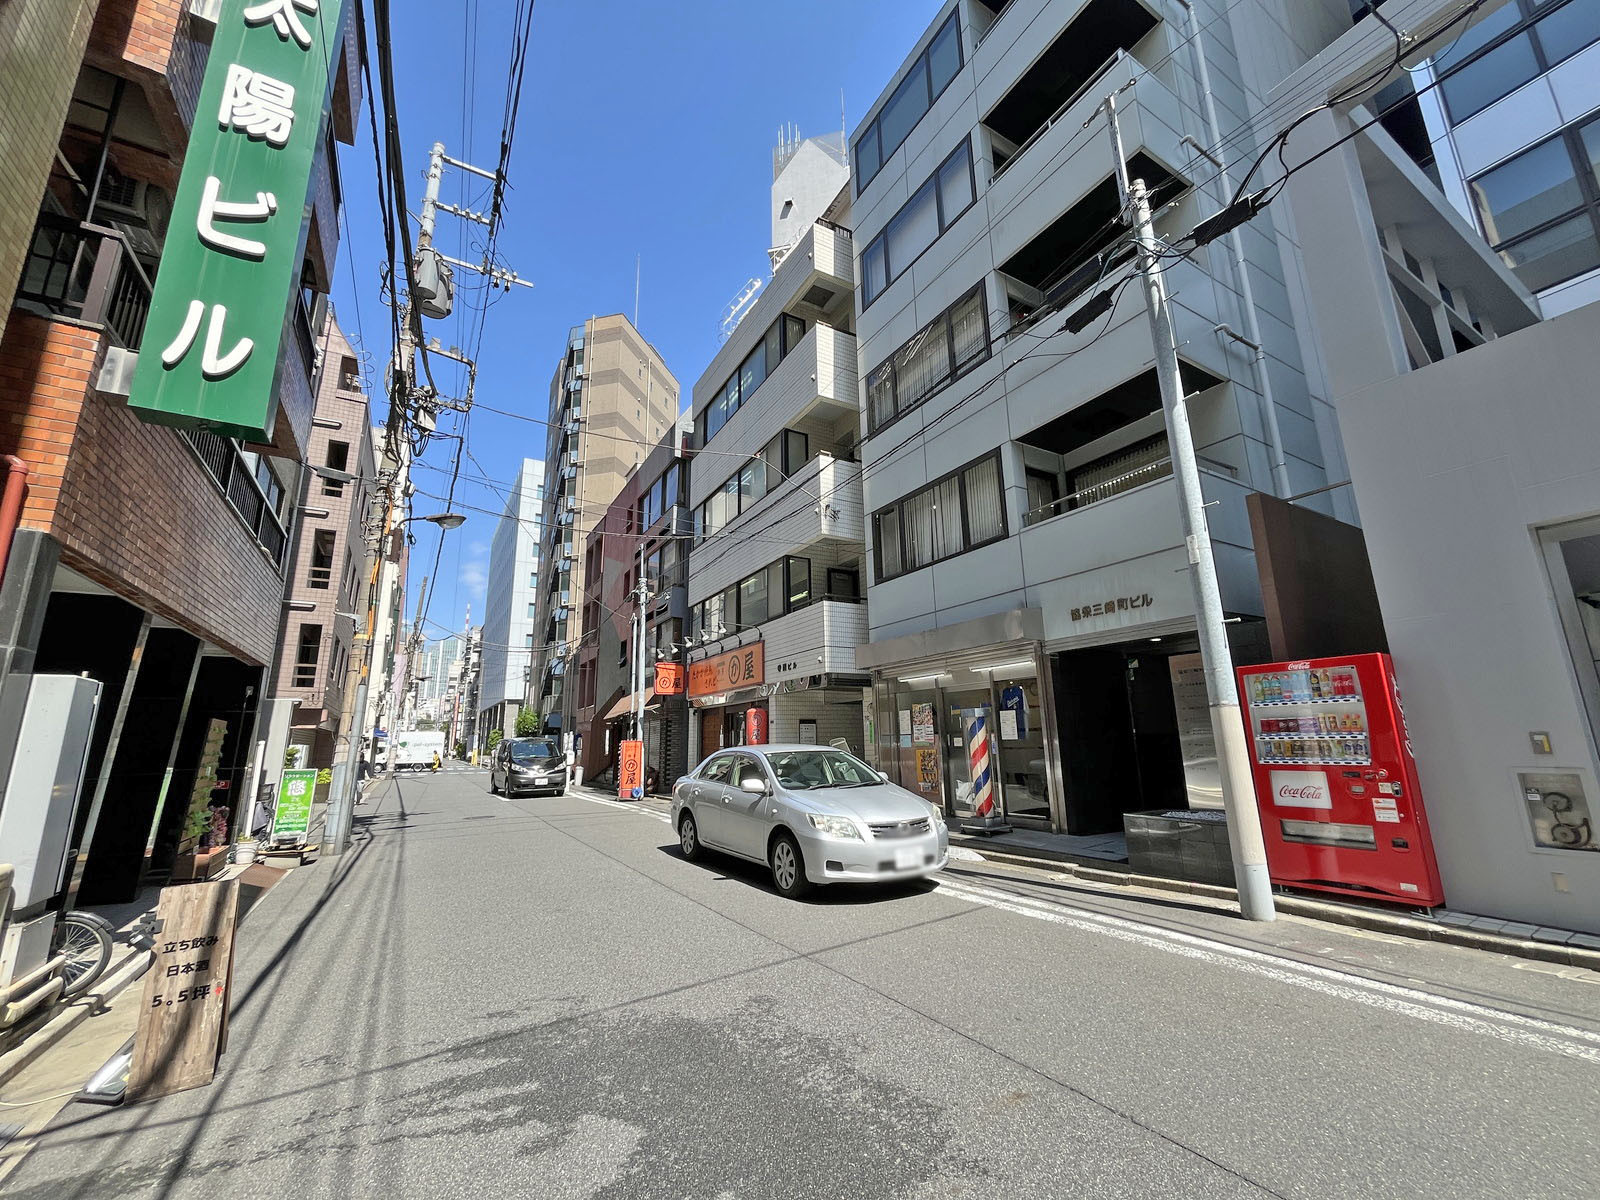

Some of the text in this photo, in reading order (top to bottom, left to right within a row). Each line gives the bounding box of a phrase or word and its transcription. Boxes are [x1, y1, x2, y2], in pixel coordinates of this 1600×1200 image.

[162, 936, 219, 954] 立ち飲み
[166, 960, 211, 978] 日本酒
